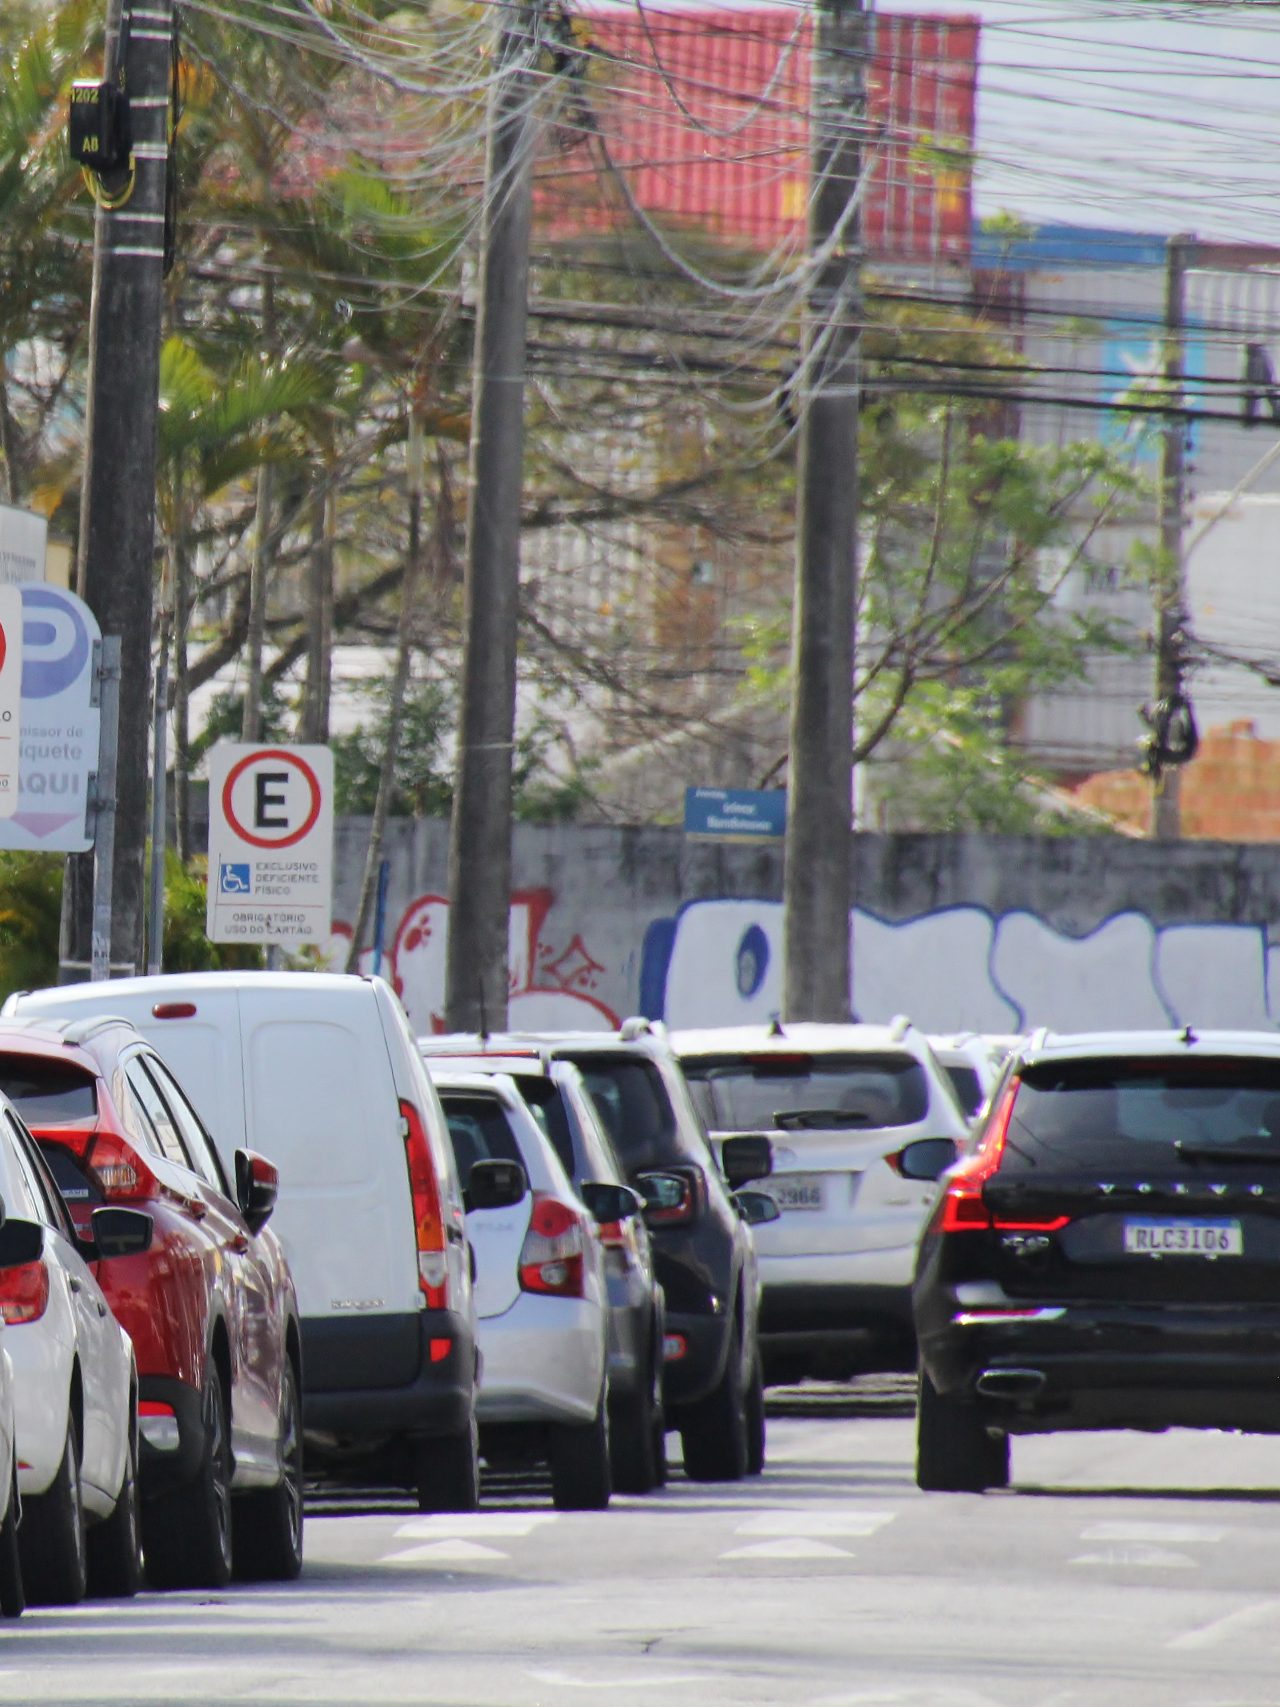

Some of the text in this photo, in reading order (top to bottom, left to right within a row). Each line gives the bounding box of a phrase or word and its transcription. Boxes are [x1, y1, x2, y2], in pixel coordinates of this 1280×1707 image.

[66, 725, 83, 738] de
[255, 773, 289, 828] E
[255, 862, 318, 871] EXCLUSIVO
[255, 873, 319, 884] DEFICIENTE
[255, 884, 291, 895] FÍSICO
[232, 911, 306, 923] OBRIGATÓRIO
[224, 925, 247, 934] USO
[249, 925, 264, 934] DO
[1098, 1182, 1265, 1196] VOLVO
